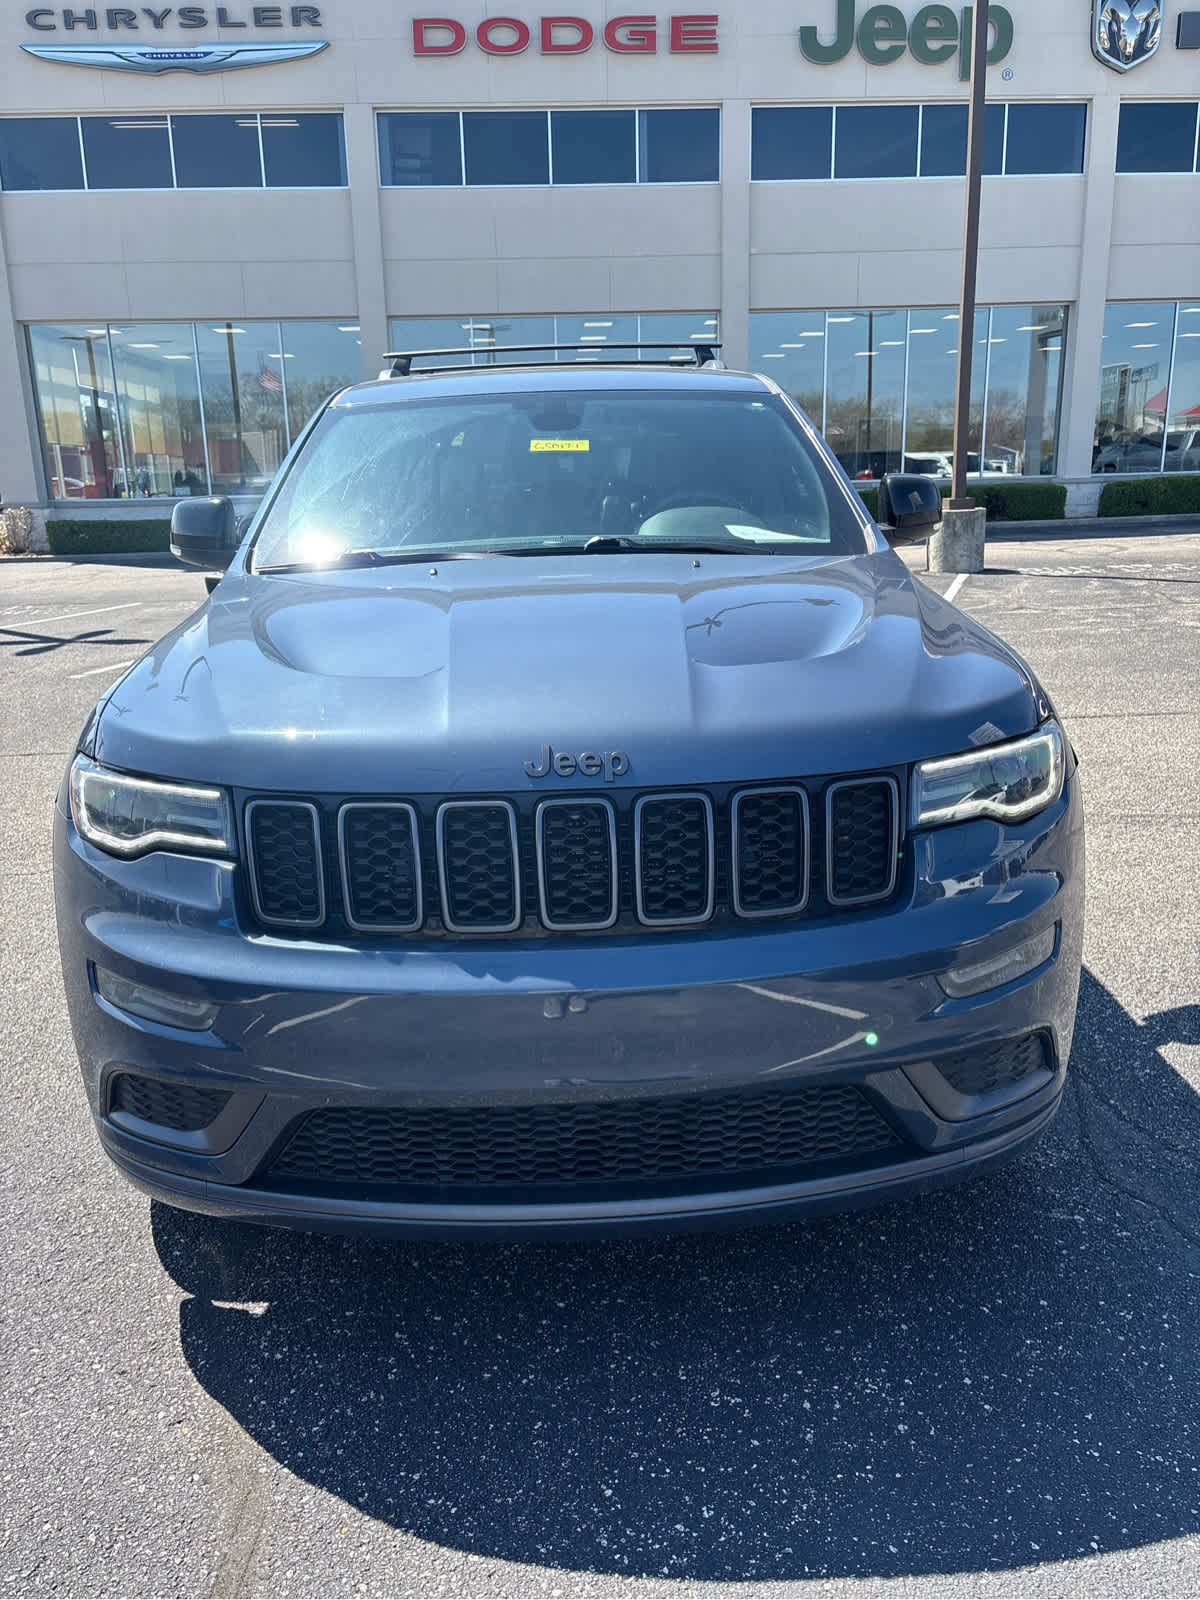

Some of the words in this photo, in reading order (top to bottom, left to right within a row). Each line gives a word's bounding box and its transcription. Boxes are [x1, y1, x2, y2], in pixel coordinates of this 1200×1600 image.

[24, 5, 323, 31] CHRYSLER
[412, 14, 719, 57] DODGE
[799, 0, 1014, 81] Jeep
[523, 743, 631, 783] Jeep
